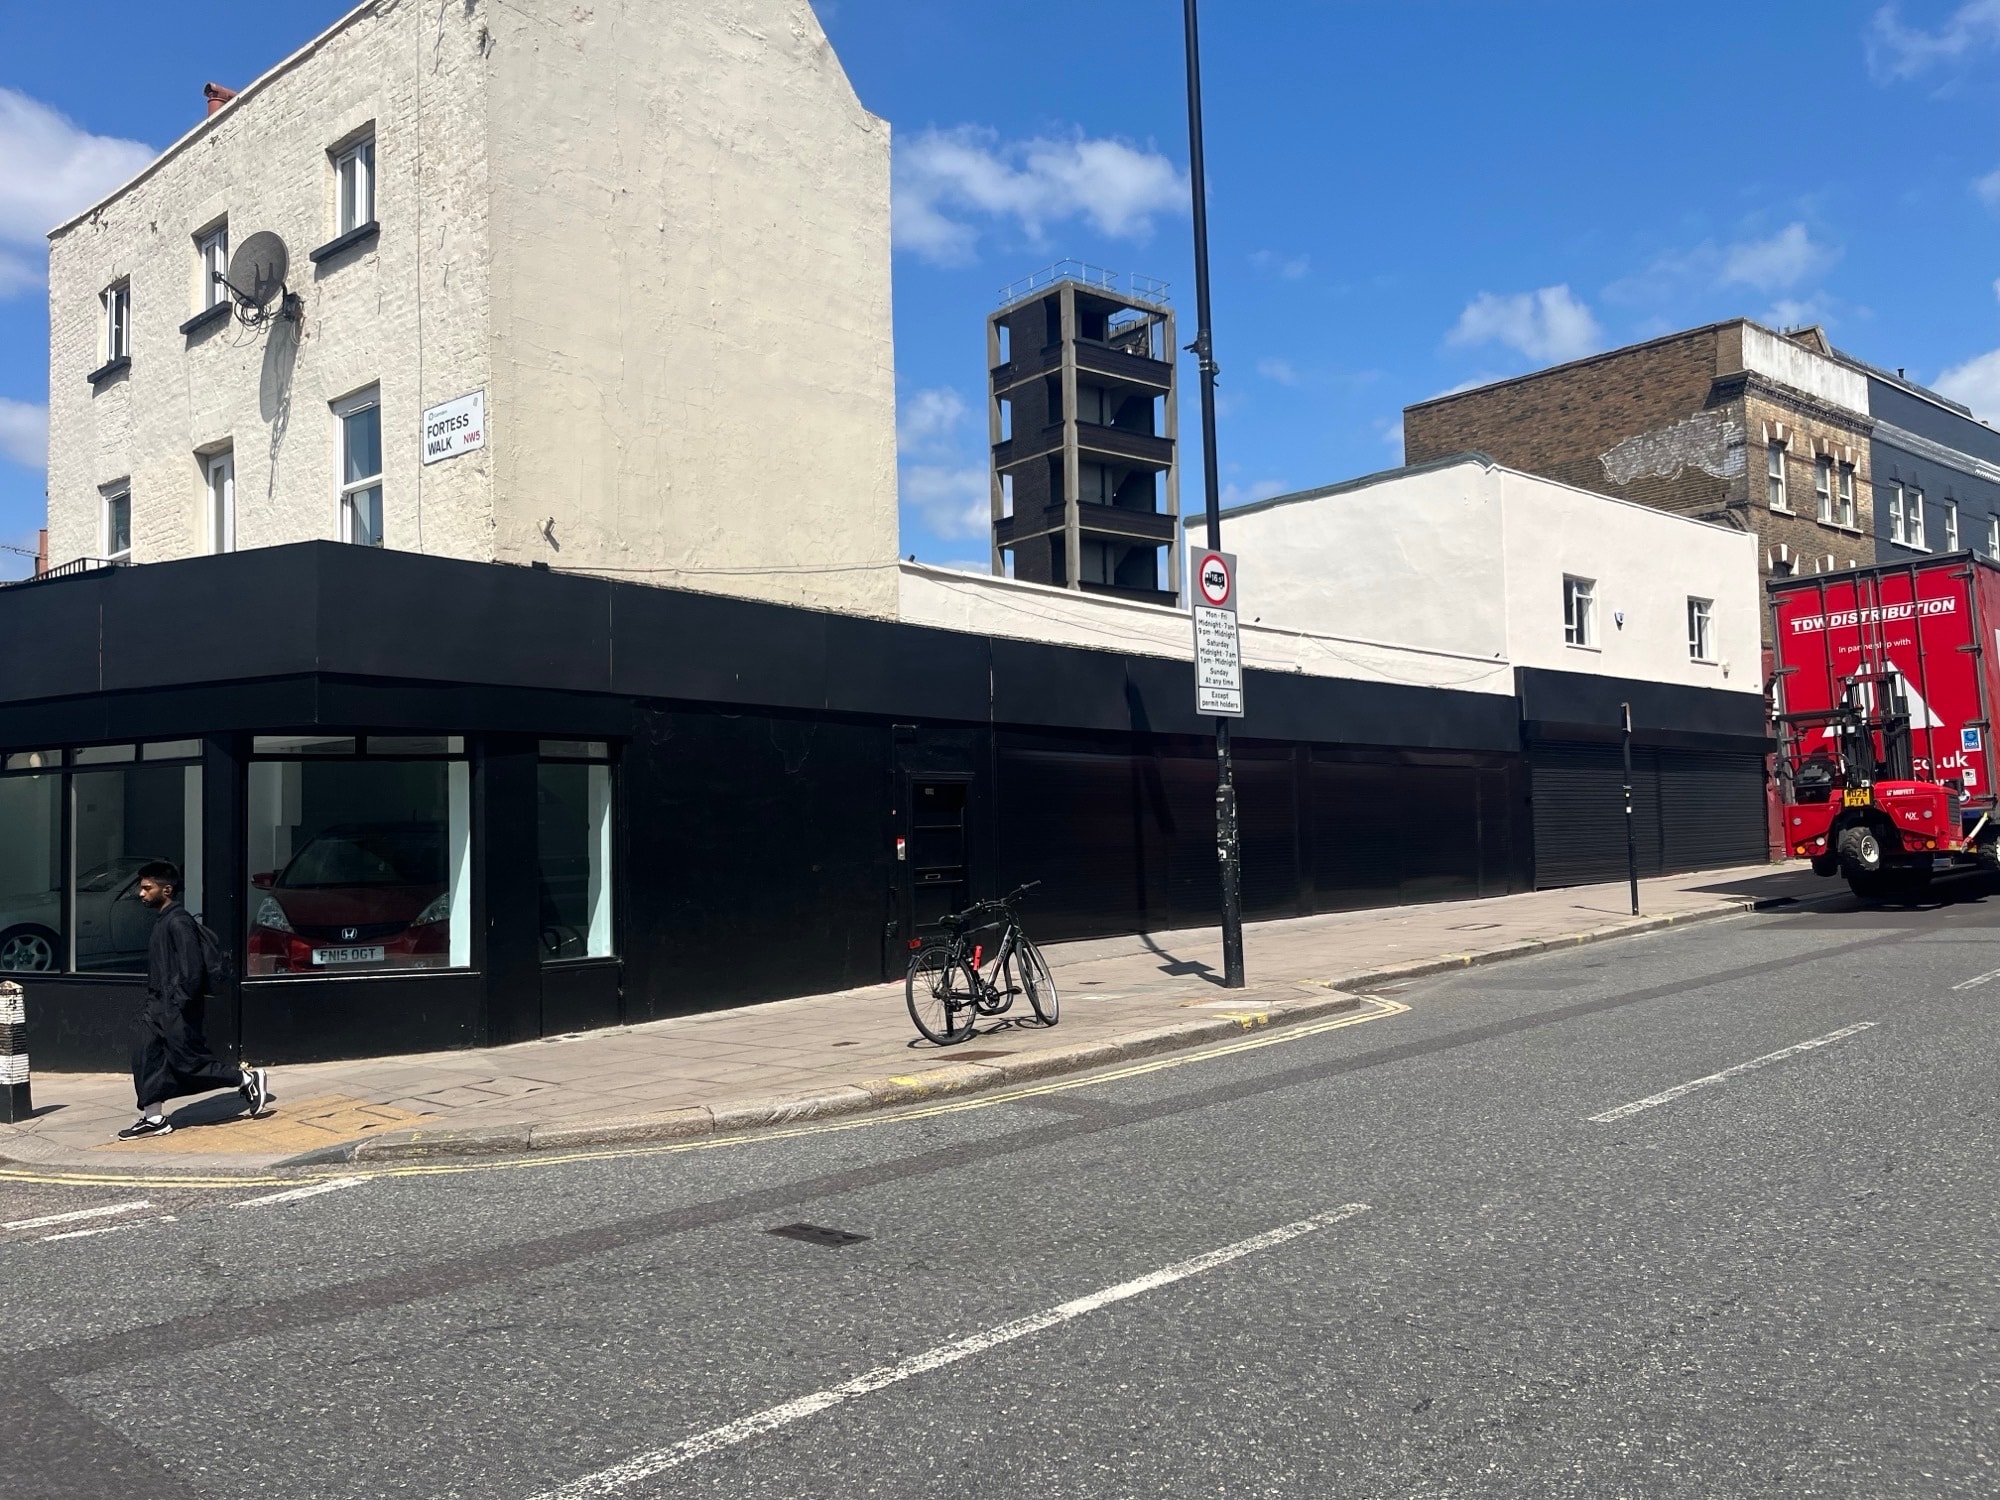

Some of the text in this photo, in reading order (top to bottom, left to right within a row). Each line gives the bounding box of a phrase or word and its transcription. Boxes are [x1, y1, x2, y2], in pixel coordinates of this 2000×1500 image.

[427, 413, 469, 438] FORTESS
[428, 430, 480, 456] WALK NW5
[1198, 619, 1221, 628] Midnight
[1214, 630, 1235, 639] Midnight
[1207, 639, 1229, 649] Saturday
[1893, 637, 1911, 647] with
[1200, 648, 1222, 657] Midnight
[1215, 658, 1236, 667] Midnight
[1210, 667, 1228, 677] Sunday
[1212, 691, 1229, 700] Except
[320, 948, 376, 961] FN15 OGT
